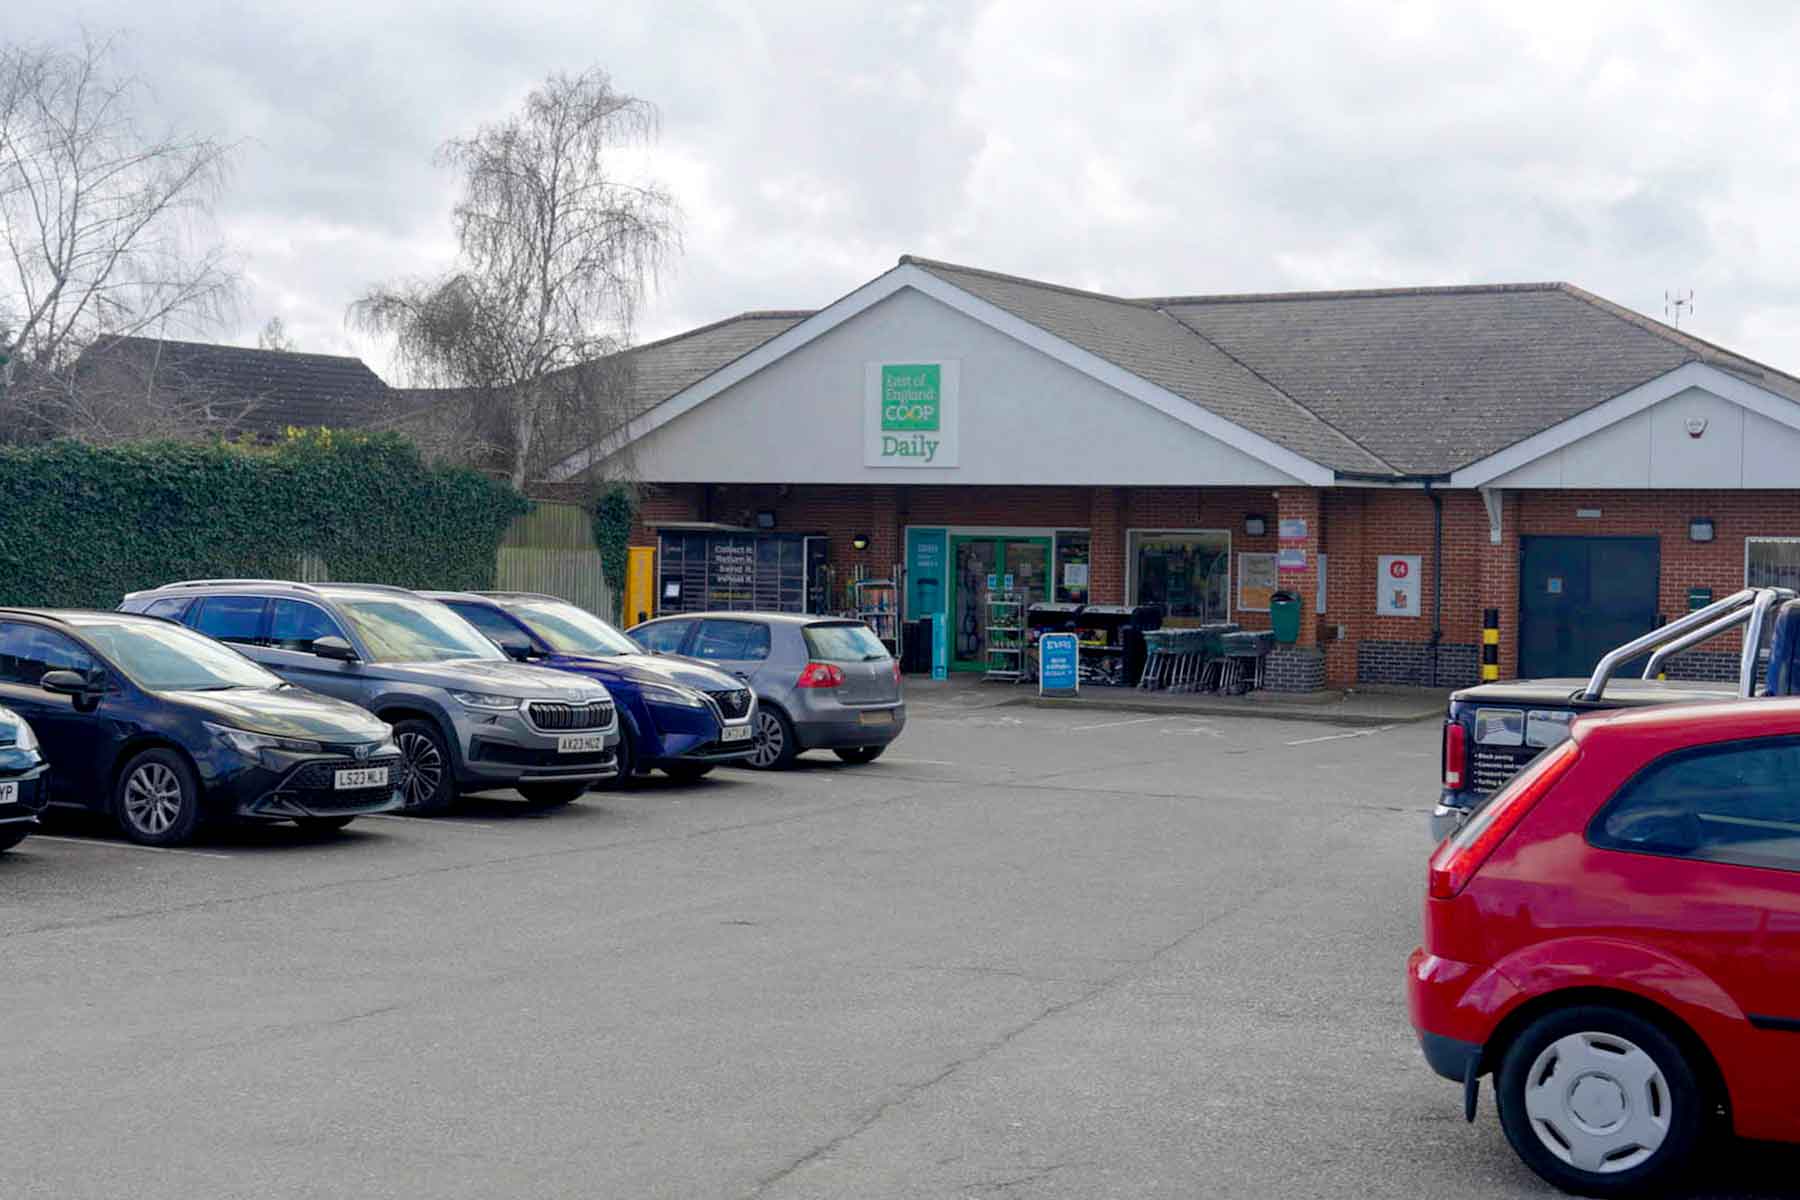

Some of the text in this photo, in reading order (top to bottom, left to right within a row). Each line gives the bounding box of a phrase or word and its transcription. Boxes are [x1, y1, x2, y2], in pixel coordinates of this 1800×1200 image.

[912, 373, 927, 385] of
[887, 386, 937, 403] England
[882, 434, 939, 463] Daily
[339, 771, 366, 786] LS23
